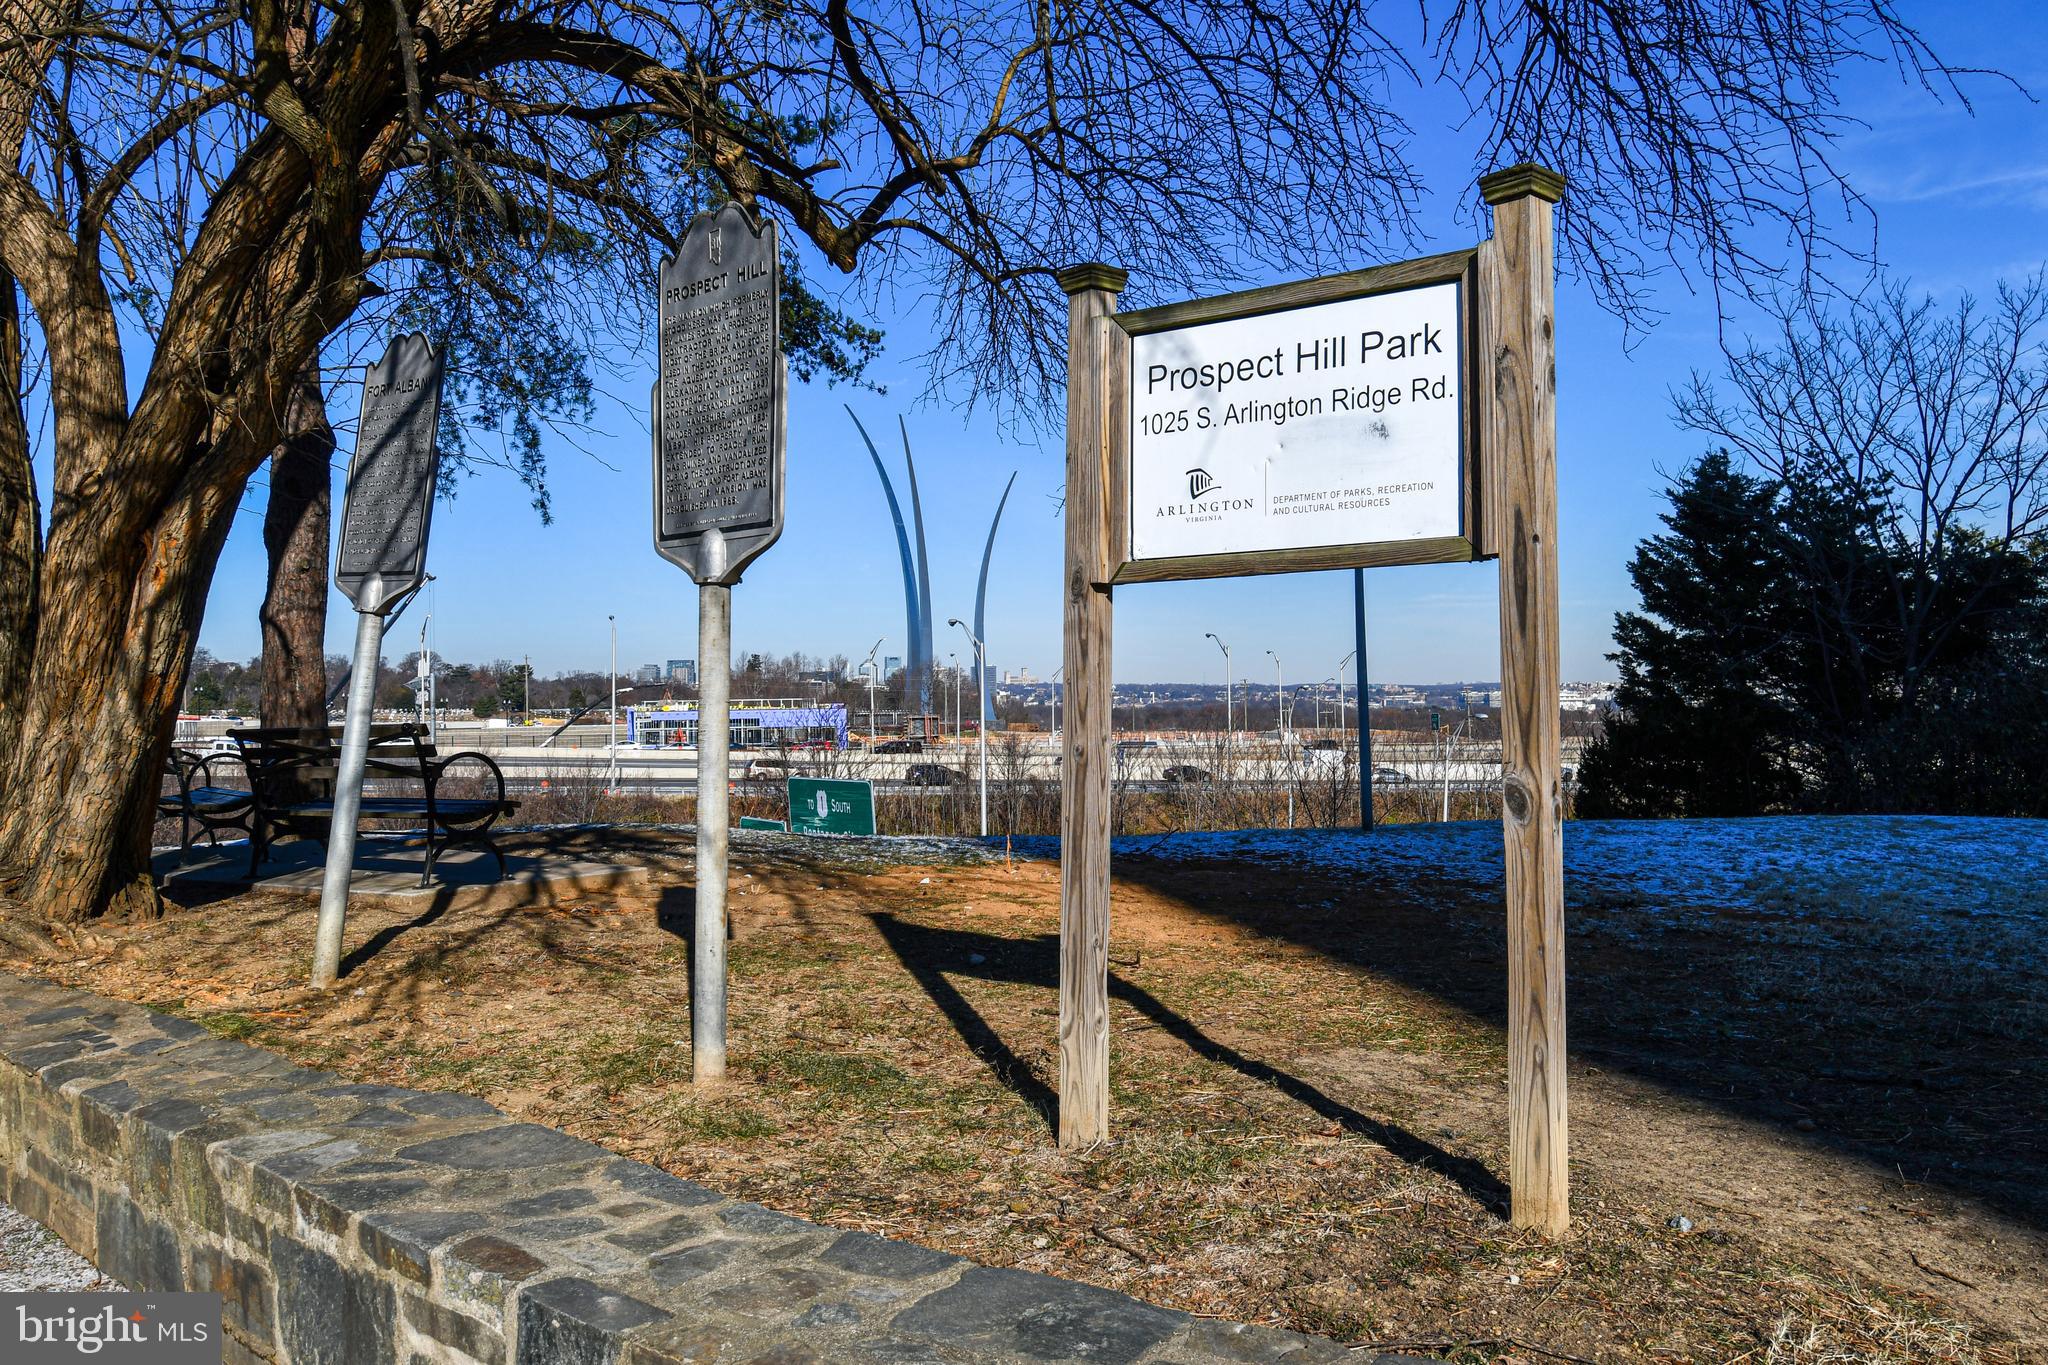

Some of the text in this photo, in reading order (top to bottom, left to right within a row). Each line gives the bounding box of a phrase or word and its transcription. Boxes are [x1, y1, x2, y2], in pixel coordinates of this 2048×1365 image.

[666, 261, 768, 304] PROSPECT HILL
[664, 289, 768, 326] THE MANSION WHICH FORMERLY
[665, 325, 685, 336] STOOD
[688, 319, 704, 330] HERE
[708, 314, 721, 324] WAS
[725, 308, 742, 319] BUILT
[747, 305, 753, 313] IN
[665, 323, 768, 357] CONTRACTOR WHO SUPPLIED
[674, 332, 695, 344] JAMES
[729, 312, 769, 329] PROSPEROUS
[665, 334, 768, 368] MOST OF THE BRICK AND STONE
[665, 344, 769, 378] USED IN THE CONSTRUCTION OF
[1149, 324, 1442, 394] Prospect Hill Park
[665, 368, 768, 400] ALEXANDRIA CANAL (UNDER
[666, 356, 768, 389] THE AQUEDUCT BRIDGE AND
[368, 376, 433, 398] FORT ALBANY
[665, 390, 719, 409] CONSTRUCTION
[666, 411, 678, 420] AND
[680, 408, 693, 416] THE
[666, 401, 768, 431] AND HAMPSHIRE RAILROAD
[1141, 376, 1454, 436] 1025 S. Arlington Ridge Rd.
[666, 428, 692, 441] (UNDER
[695, 416, 748, 435] CONSTRUCTION
[694, 436, 703, 445] HIS
[747, 423, 768, 434] WHICH
[666, 448, 702, 462] EXTENDED
[707, 445, 714, 454] TO
[666, 446, 766, 472] WAS RUINED AND VANDALIZED
[666, 456, 767, 482] DURING THE CONSTRUCTION OF
[666, 484, 681, 492] FORT
[710, 476, 721, 485] AND
[723, 473, 739, 482] FORT
[741, 468, 766, 479] ALBANY
[700, 489, 710, 498] HIS
[715, 482, 748, 495] MANSION
[752, 479, 767, 488] WAS
[1273, 482, 1434, 504] DEPARTMENT OF PARKS, RECREATION
[666, 501, 708, 514] DEMOLISHED
[710, 499, 717, 507] IN
[1156, 498, 1254, 517] ARLINGTON
[1273, 498, 1390, 515] AND CULTURAL RESOURCES
[808, 799, 814, 810] TO
